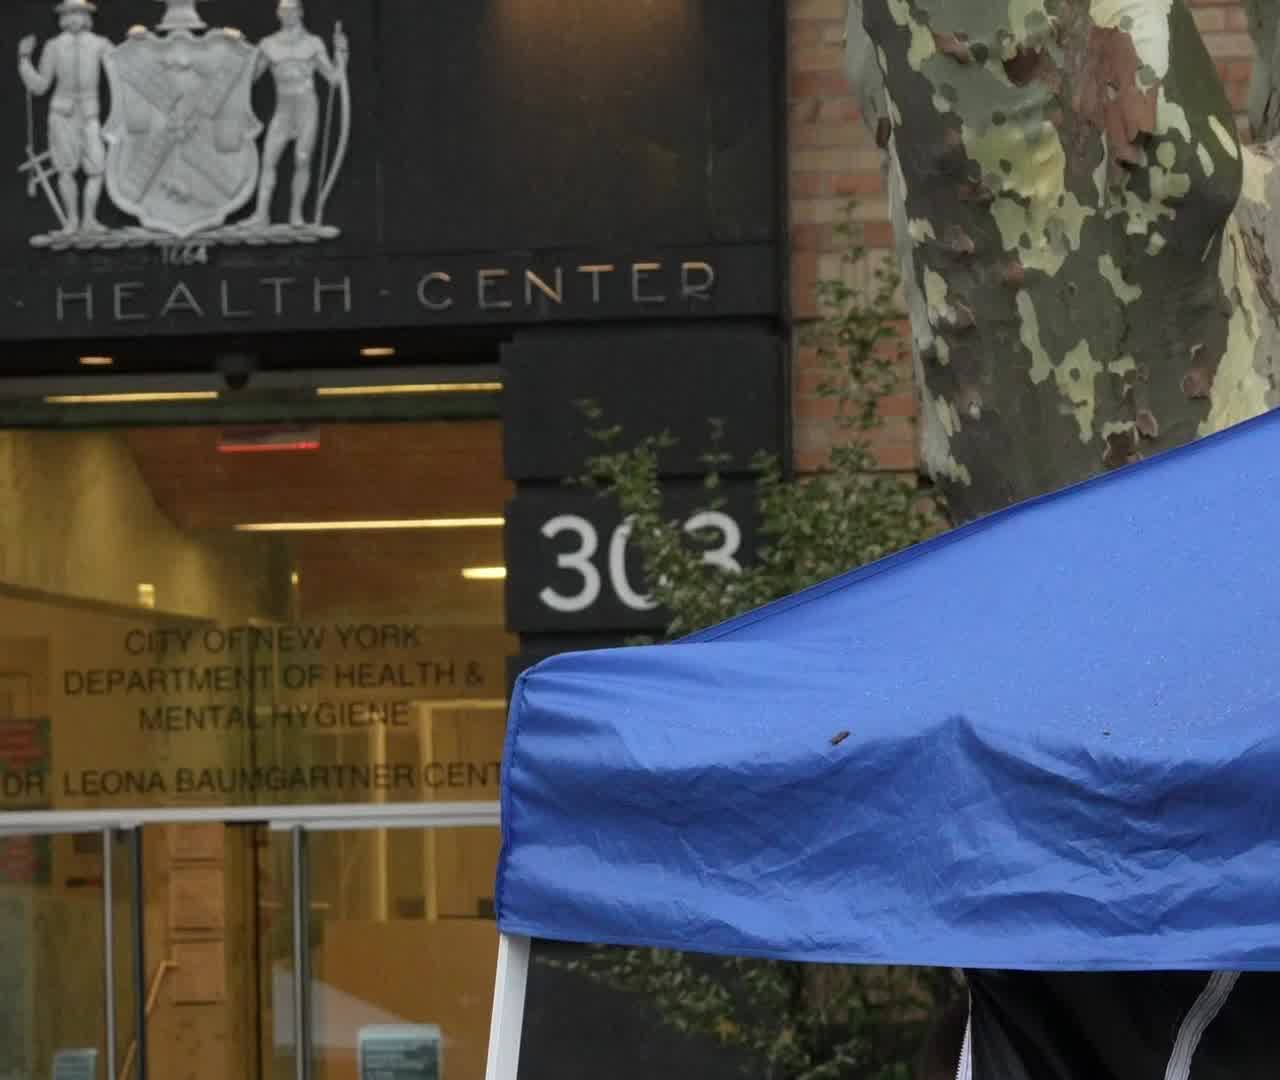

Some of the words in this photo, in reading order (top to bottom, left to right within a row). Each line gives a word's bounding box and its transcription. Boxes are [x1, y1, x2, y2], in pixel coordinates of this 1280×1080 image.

[54, 276, 351, 321] HEALTH
[417, 261, 715, 311] CENTER
[125, 628, 193, 655] CITY
[203, 626, 245, 653] OF
[253, 623, 325, 651] NEW
[334, 623, 421, 649] YORK
[63, 665, 274, 696] DEPARTMENT
[283, 663, 323, 689] OF
[334, 659, 456, 689] HEALTH
[464, 660, 484, 687] &
[138, 703, 266, 732] MENTAL
[270, 700, 410, 729] HYGIENE
[63, 768, 168, 797] LEONA
[175, 762, 416, 793] BAUMGARTNER
